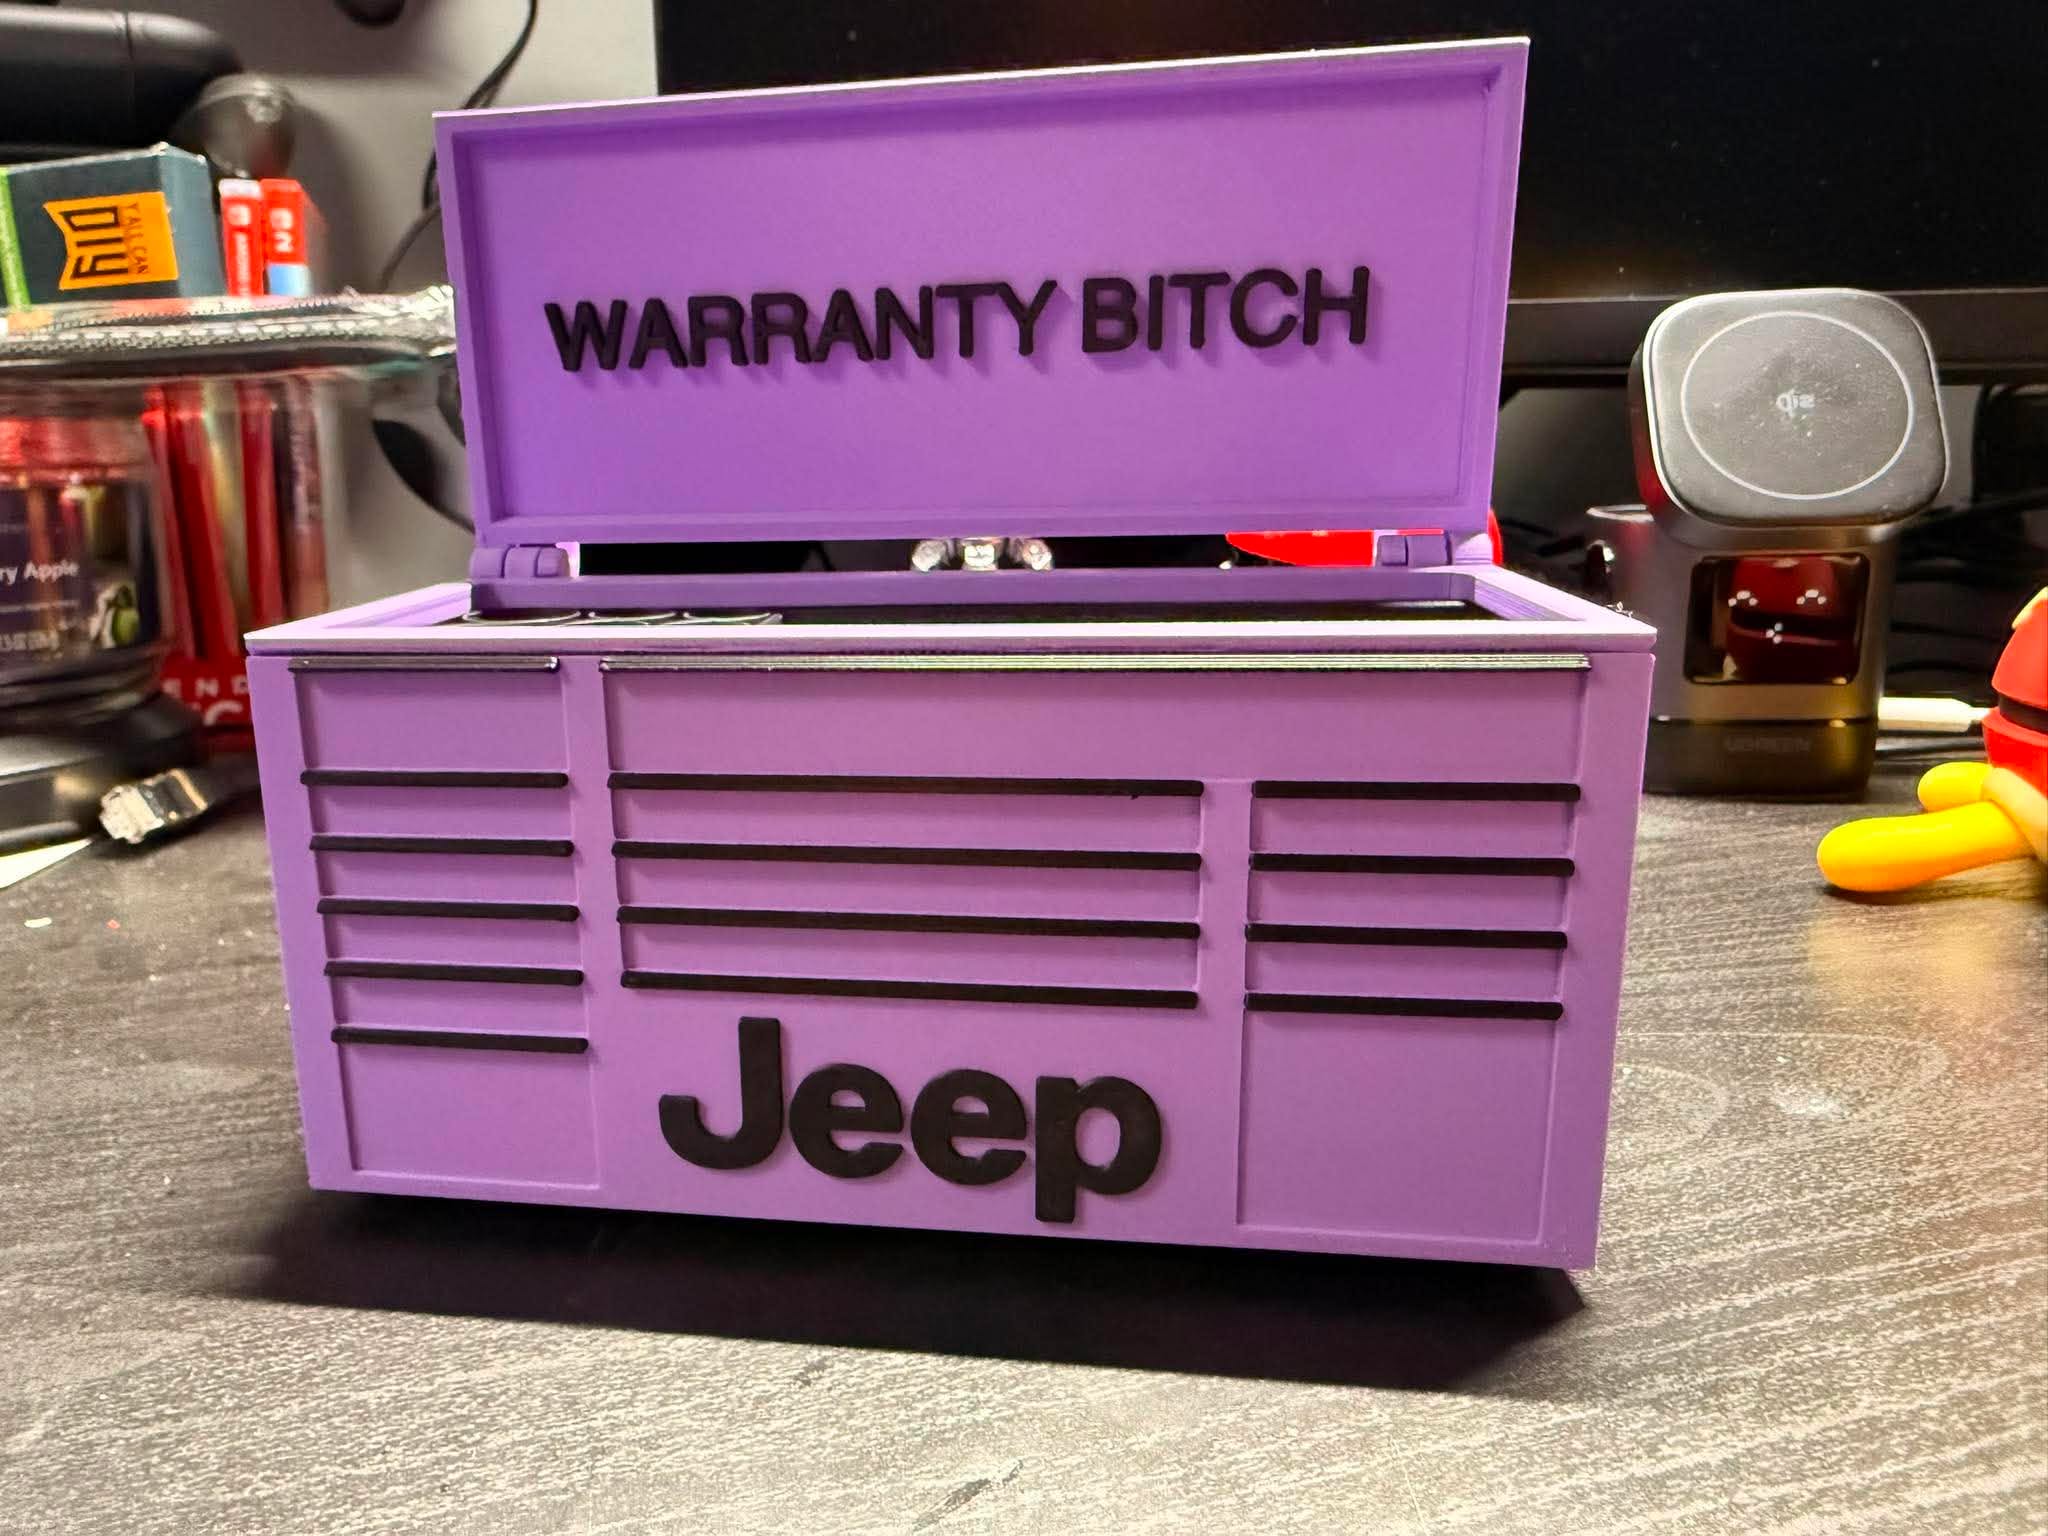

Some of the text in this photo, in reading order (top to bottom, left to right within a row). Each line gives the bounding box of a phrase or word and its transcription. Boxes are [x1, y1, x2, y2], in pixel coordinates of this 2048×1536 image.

[59, 206, 129, 279] DIY
[544, 266, 1370, 372] WARRANTY BITCH
[24, 559, 80, 582] Apple
[658, 1016, 1162, 1223] Jeep
